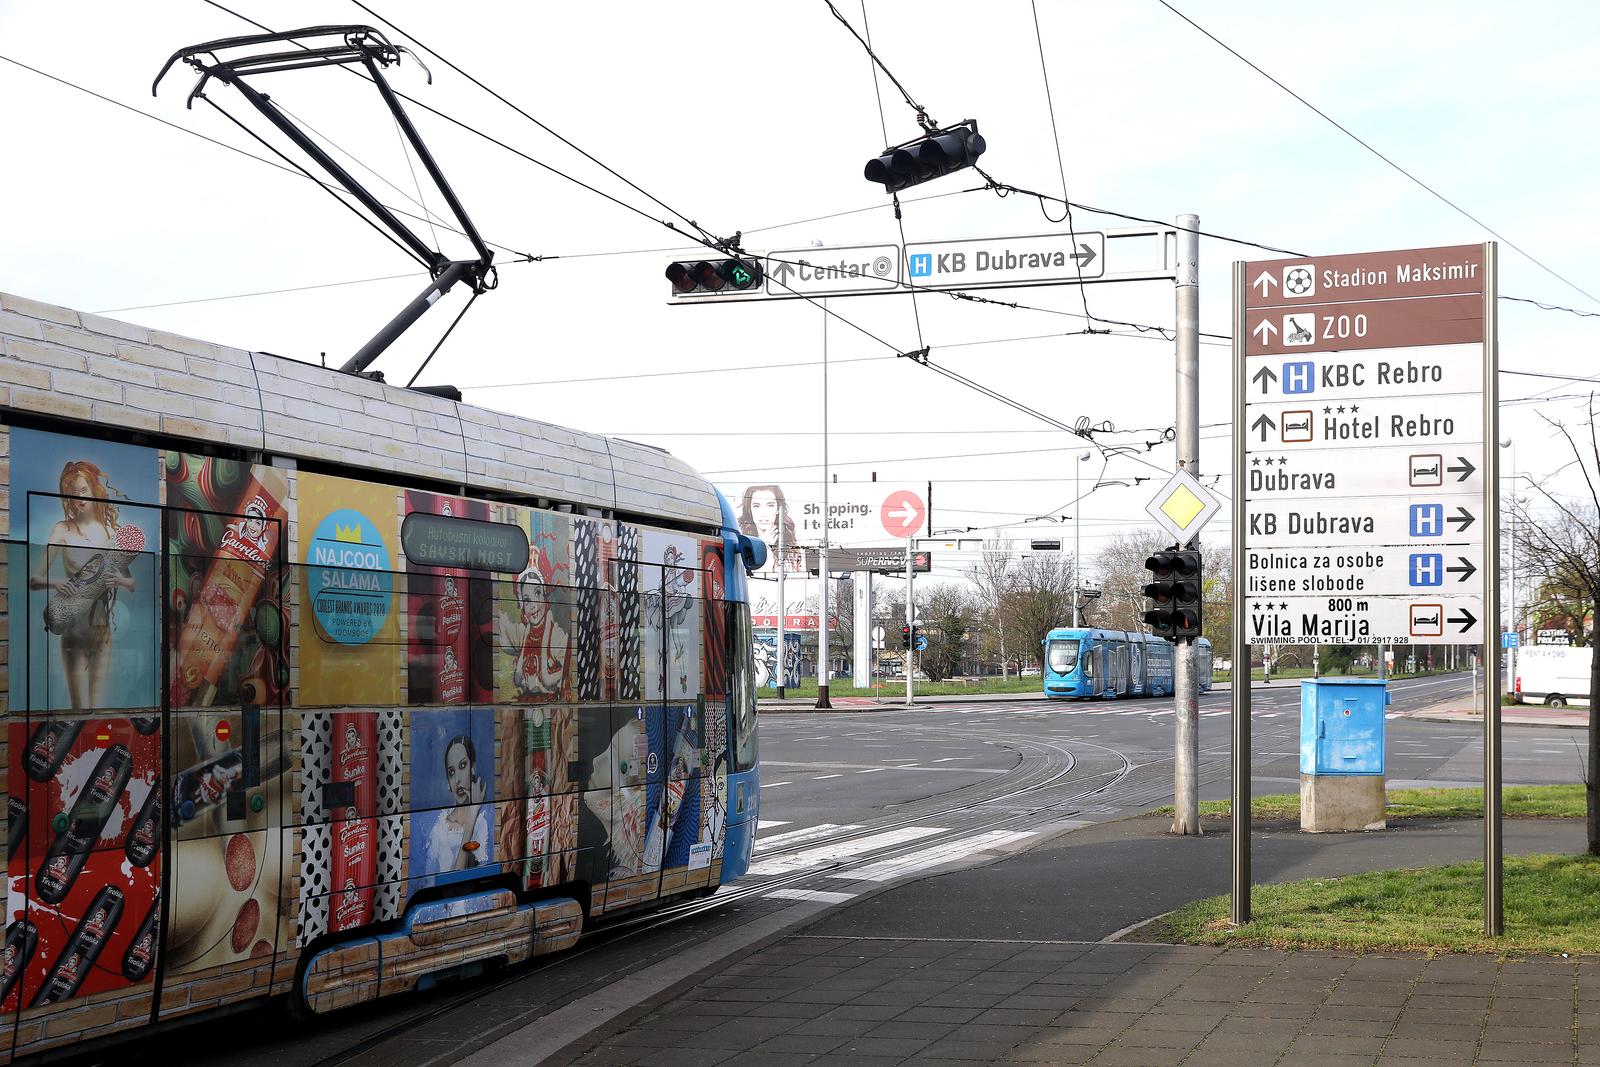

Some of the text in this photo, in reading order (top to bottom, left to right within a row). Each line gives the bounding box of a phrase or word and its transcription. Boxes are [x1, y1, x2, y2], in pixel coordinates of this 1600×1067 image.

[799, 259, 870, 282] Centar
[937, 253, 966, 273] KB
[976, 248, 1065, 272] Dubrava
[1323, 261, 1478, 289] Stadion Maksimir
[1322, 314, 1368, 339] ZOO
[1322, 363, 1365, 388] KBC
[1378, 361, 1442, 385] Rebro
[1324, 414, 1454, 440] Hotel Rebro
[1250, 469, 1336, 492] Dubrava
[803, 502, 872, 518] Shpping.
[1250, 513, 1277, 536] KB
[1288, 512, 1374, 535] Dubrava
[428, 526, 471, 545] Autobusni
[315, 547, 384, 570] NAJCOOL
[419, 543, 513, 565] SAVSKI MOST
[856, 555, 908, 567] SUPERNOV
[1250, 553, 1307, 569] Bolnica
[1313, 556, 1330, 569] za
[1336, 551, 1384, 568] osobe
[322, 570, 381, 591] SALAMA
[1249, 574, 1364, 592] lišene slobode
[1328, 599, 1369, 612] 800 m
[1252, 613, 1370, 642] Vila Marija
[1250, 636, 1409, 645] SWIMMING POOL TEL: 01/ 2917 928
[343, 841, 366, 858] Šunka
